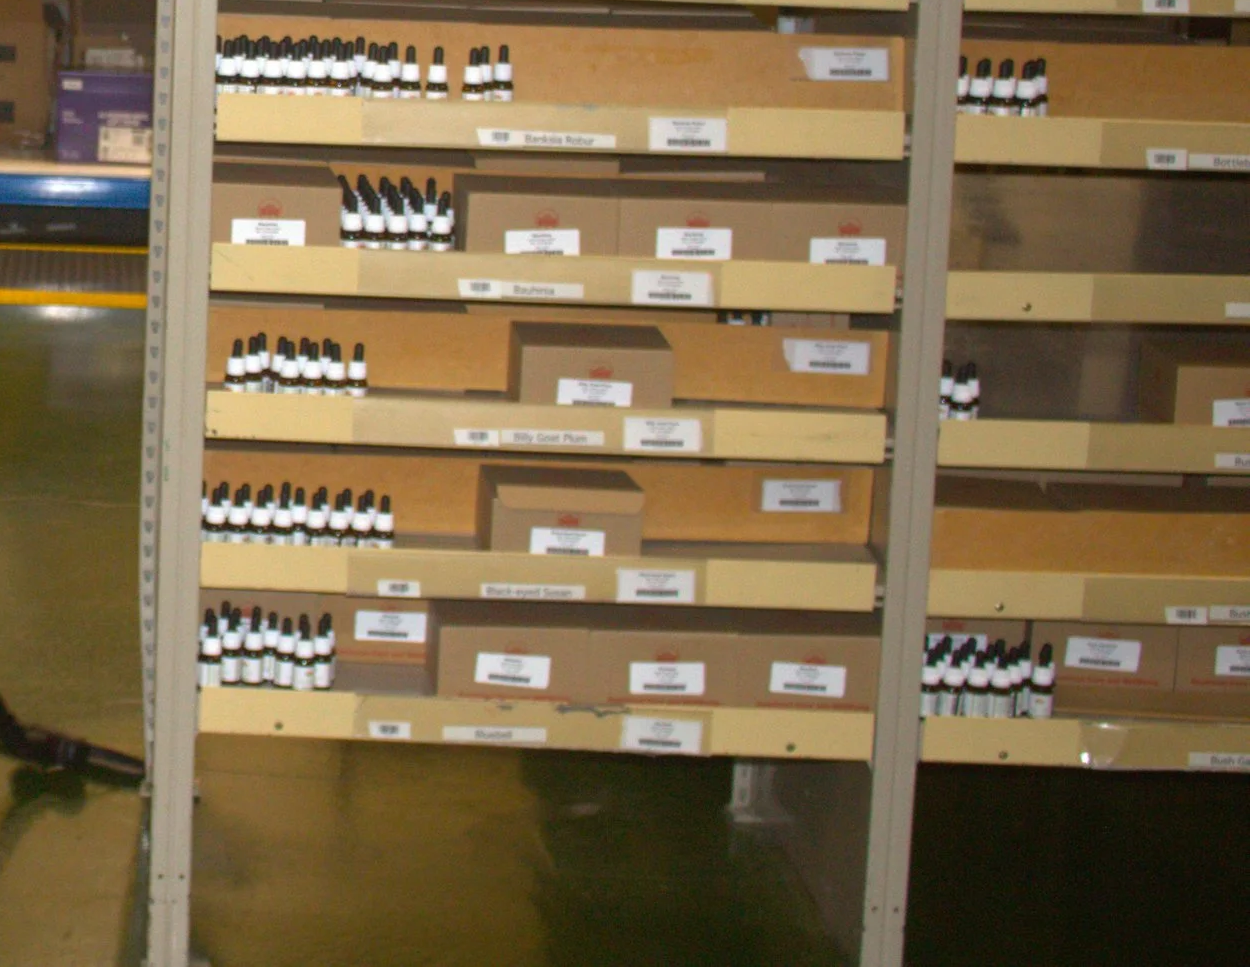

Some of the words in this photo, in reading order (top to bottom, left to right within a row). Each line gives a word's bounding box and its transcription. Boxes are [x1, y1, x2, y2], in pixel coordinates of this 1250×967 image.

[524, 133, 563, 144] Banksia
[566, 135, 595, 146] Robur
[513, 284, 555, 296] Bauhinia
[513, 432, 534, 444] Billy
[537, 433, 560, 443] Goat
[563, 434, 588, 444] Plum
[485, 586, 541, 599] Black-eyed
[543, 588, 572, 598] Susan
[475, 730, 513, 740] Bluebell
[1210, 756, 1235, 766] Bush
